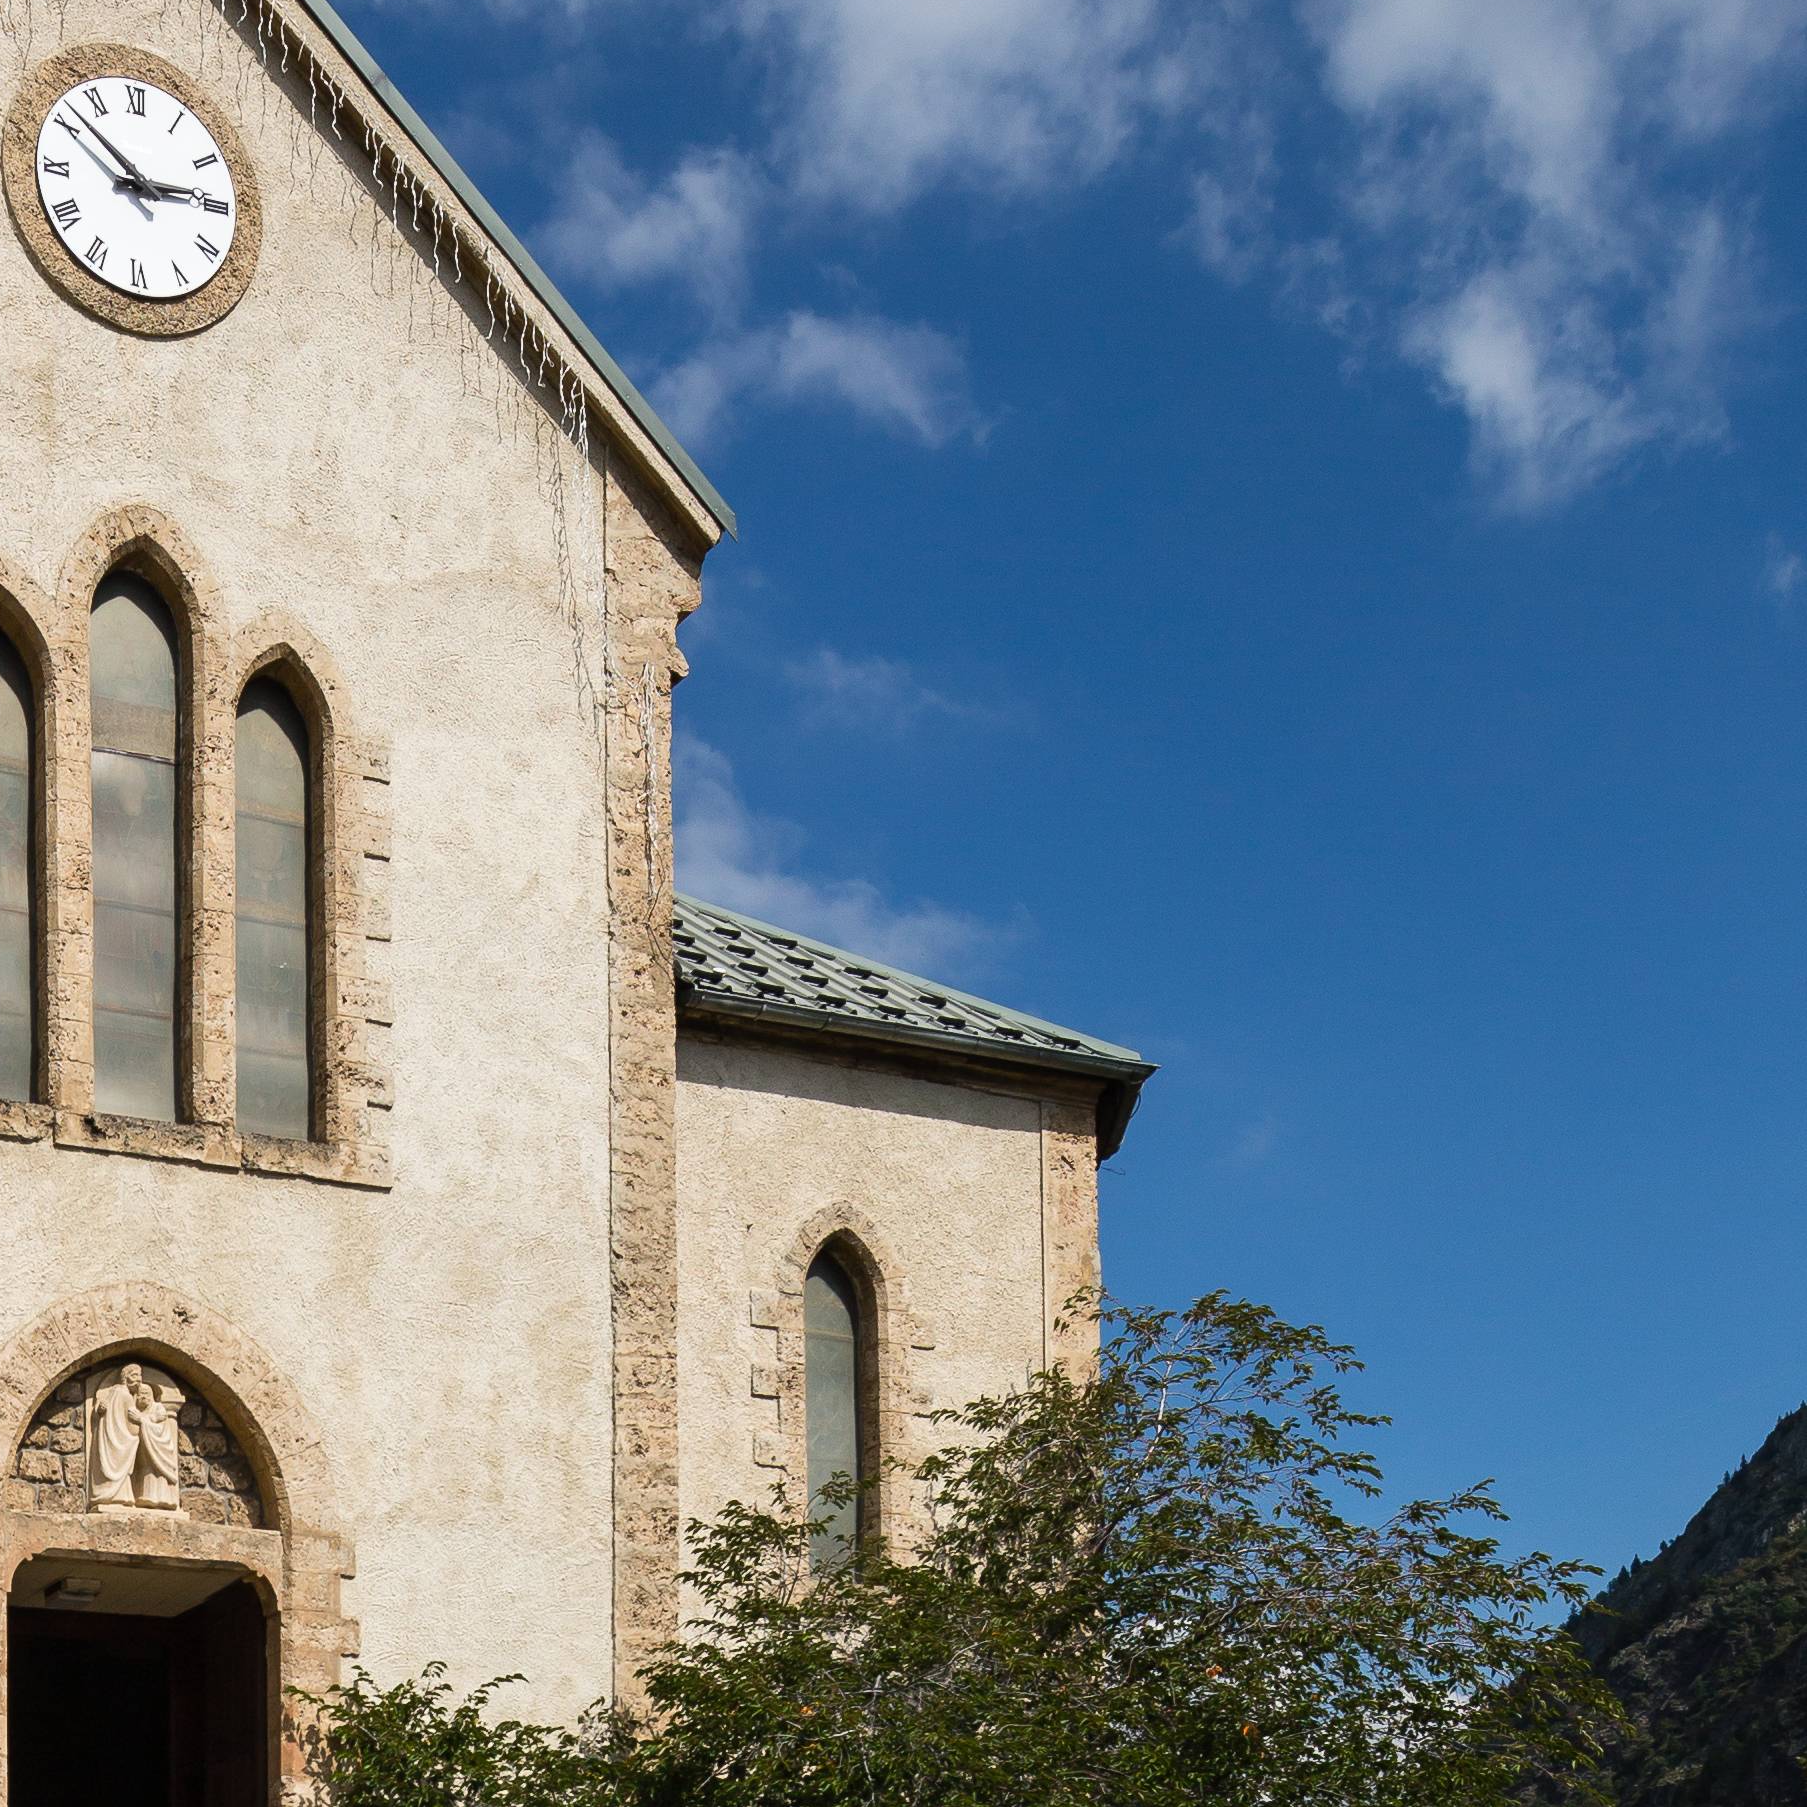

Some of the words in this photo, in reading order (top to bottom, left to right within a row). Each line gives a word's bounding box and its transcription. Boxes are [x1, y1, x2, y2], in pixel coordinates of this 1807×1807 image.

[83, 86, 109, 118] XI
[125, 84, 147, 117] XII
[53, 112, 81, 139] X
[168, 110, 185, 135] I
[43, 155, 70, 179] IX
[192, 152, 218, 170] II
[51, 197, 82, 232] VIII
[204, 197, 229, 217] III
[84, 235, 109, 272] VII
[194, 233, 220, 264] IV
[130, 258, 149, 290] VI
[171, 260, 190, 287] V
